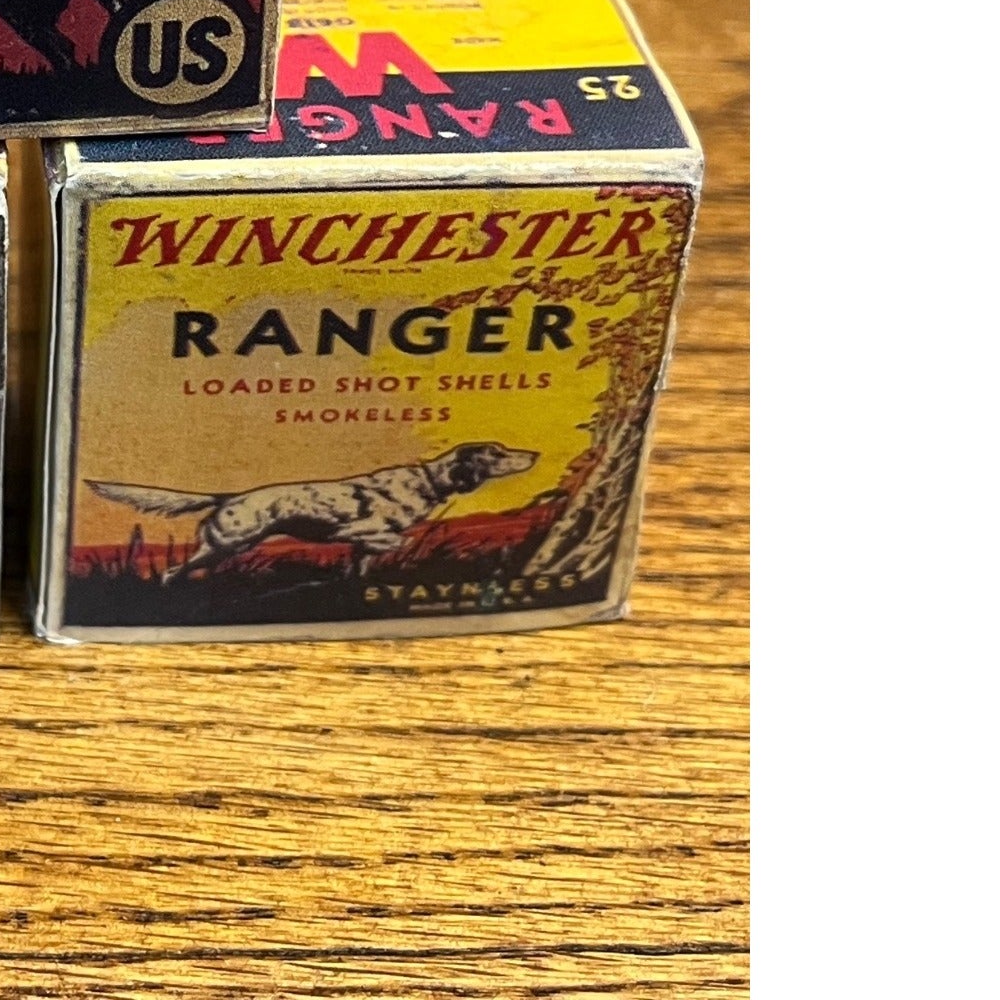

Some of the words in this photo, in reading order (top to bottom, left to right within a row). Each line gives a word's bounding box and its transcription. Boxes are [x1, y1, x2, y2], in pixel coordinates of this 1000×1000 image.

[131, 16, 233, 89] US
[577, 74, 642, 101] 25
[188, 97, 575, 144] RANG
[110, 207, 658, 268] WINCHESTER
[171, 304, 577, 359] RANGER
[183, 376, 317, 396] LOADED
[335, 374, 421, 394] SHOT
[438, 371, 553, 392] SHELLS
[274, 406, 452, 425] SMOKELESS
